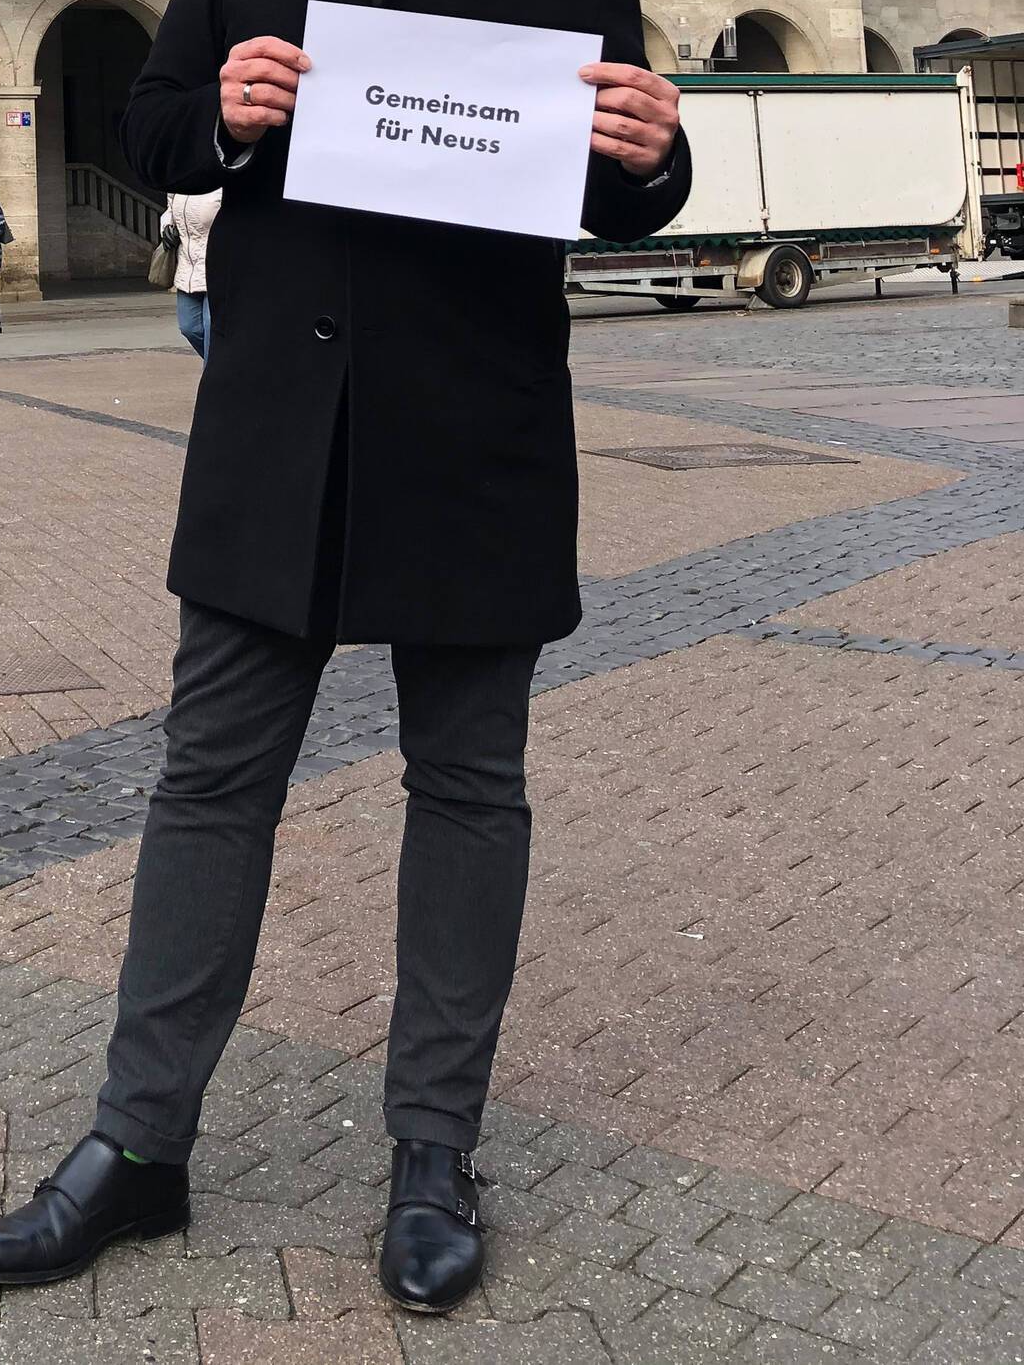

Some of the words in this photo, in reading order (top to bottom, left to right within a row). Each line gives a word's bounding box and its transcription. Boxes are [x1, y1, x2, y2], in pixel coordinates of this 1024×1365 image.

[365, 85, 520, 124] Gemeinsam
[375, 117, 413, 142] für
[420, 124, 500, 154] Neuss
